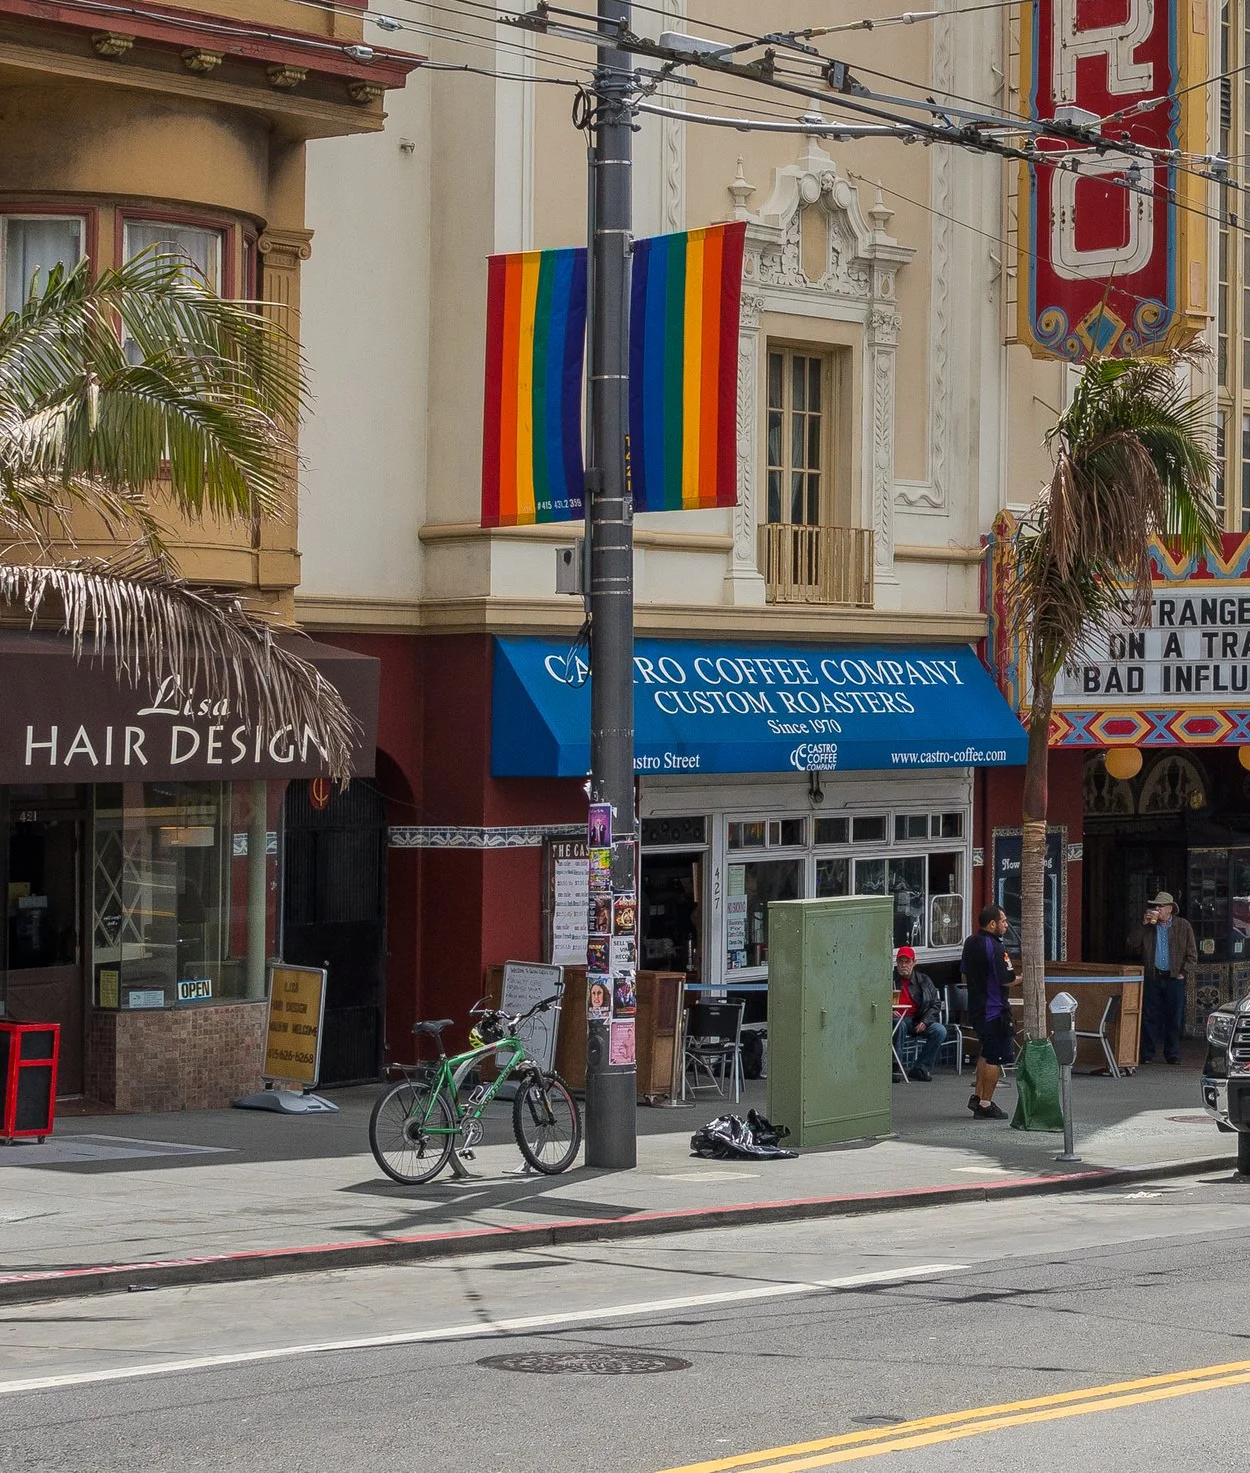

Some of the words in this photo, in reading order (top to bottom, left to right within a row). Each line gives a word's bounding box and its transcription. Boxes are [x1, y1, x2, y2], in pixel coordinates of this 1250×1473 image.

[1110, 630, 1145, 660] ON
[1163, 631, 1184, 659] A
[544, 654, 687, 684] CARO
[693, 657, 819, 685] COFFEE
[820, 659, 965, 686] COMPANY
[137, 674, 230, 717] Lisa
[653, 690, 777, 715] CUSTOM
[776, 691, 916, 714] ROASTERS
[767, 719, 808, 735] Since
[809, 718, 842, 734] 1970
[25, 724, 148, 766] HAIR
[170, 724, 330, 766] DESIGN
[807, 743, 838, 753] CASTRO
[633, 753, 661, 770] stro
[663, 751, 701, 769] Street
[807, 753, 837, 763] COFFEE
[890, 746, 1007, 764] www.castro-coffee.com
[806, 763, 836, 772] COMPANY
[19, 811, 38, 822] 421
[552, 844, 571, 858] THE
[574, 843, 590, 857] CAS
[1002, 858, 1021, 871] Now
[181, 981, 210, 999] OPEN
